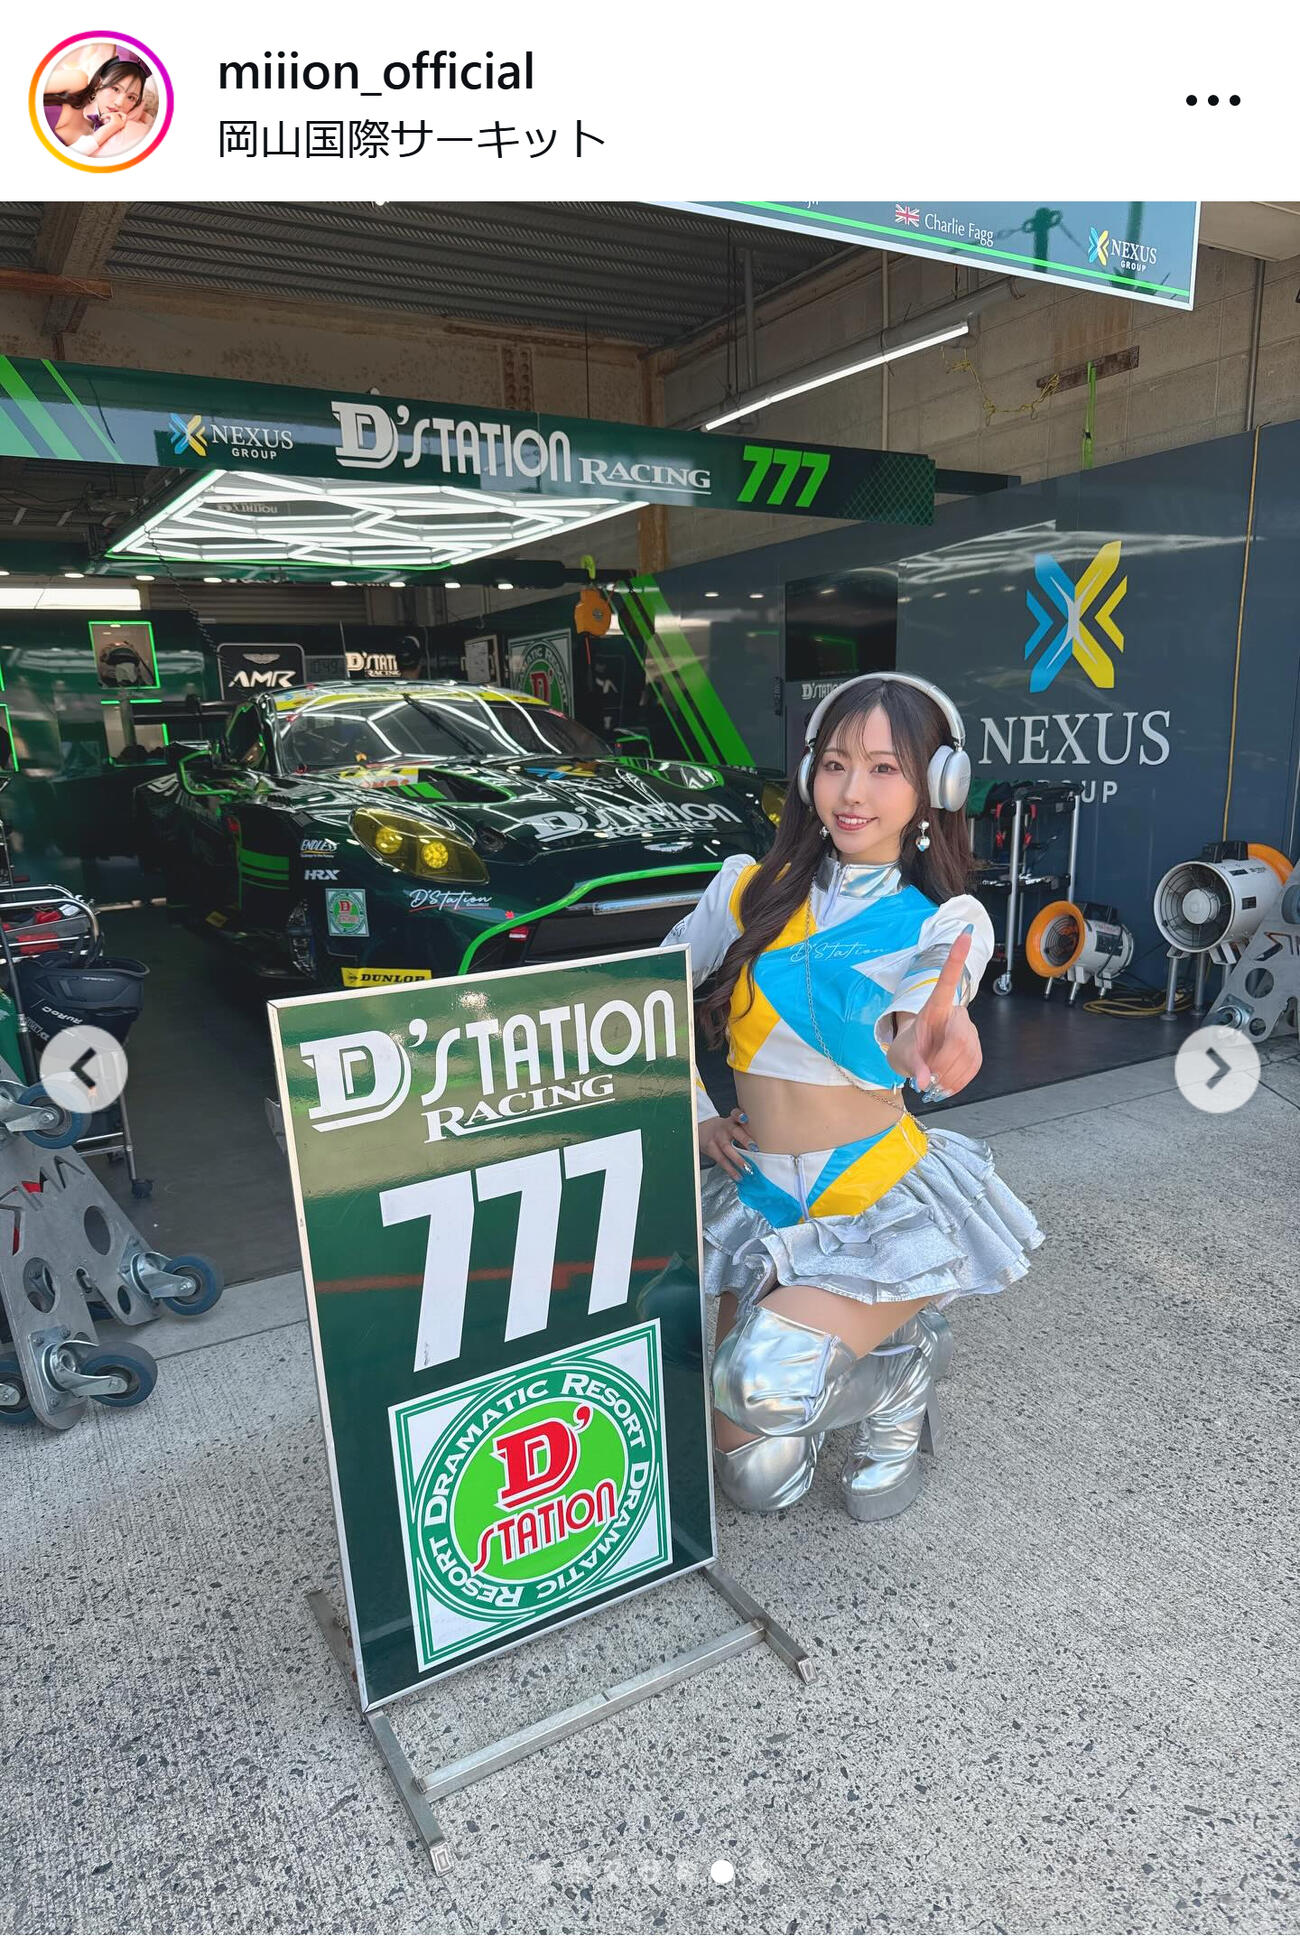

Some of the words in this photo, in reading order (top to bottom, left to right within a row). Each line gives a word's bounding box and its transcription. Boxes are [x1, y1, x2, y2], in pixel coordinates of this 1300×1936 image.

[924, 213, 965, 236] Charlie
[968, 222, 994, 248] Fagg
[1111, 238, 1157, 265] NEXUS
[1120, 260, 1147, 272] GROUP
[210, 424, 294, 450] NEXUS
[231, 447, 278, 460] GROUP
[331, 401, 572, 483] D'STATION
[578, 457, 712, 495] RACING
[737, 445, 831, 508] 777
[228, 670, 296, 688] AMR
[978, 710, 1171, 766] NEXUS
[300, 839, 339, 851] ENDLESS
[304, 869, 340, 880] HRX
[409, 888, 493, 911] D'Station
[361, 973, 425, 983] DUNLOP
[299, 989, 677, 1133] D'STATION
[422, 1074, 616, 1144] RACING
[379, 1128, 644, 1373] 777
[424, 1379, 549, 1528] DRAMATIC
[560, 1372, 647, 1449] RESORT
[494, 1404, 592, 1511] D'
[473, 1480, 618, 1574] STATION
[536, 1460, 651, 1599] DRAMATIC
[429, 1536, 525, 1608] RESORT
